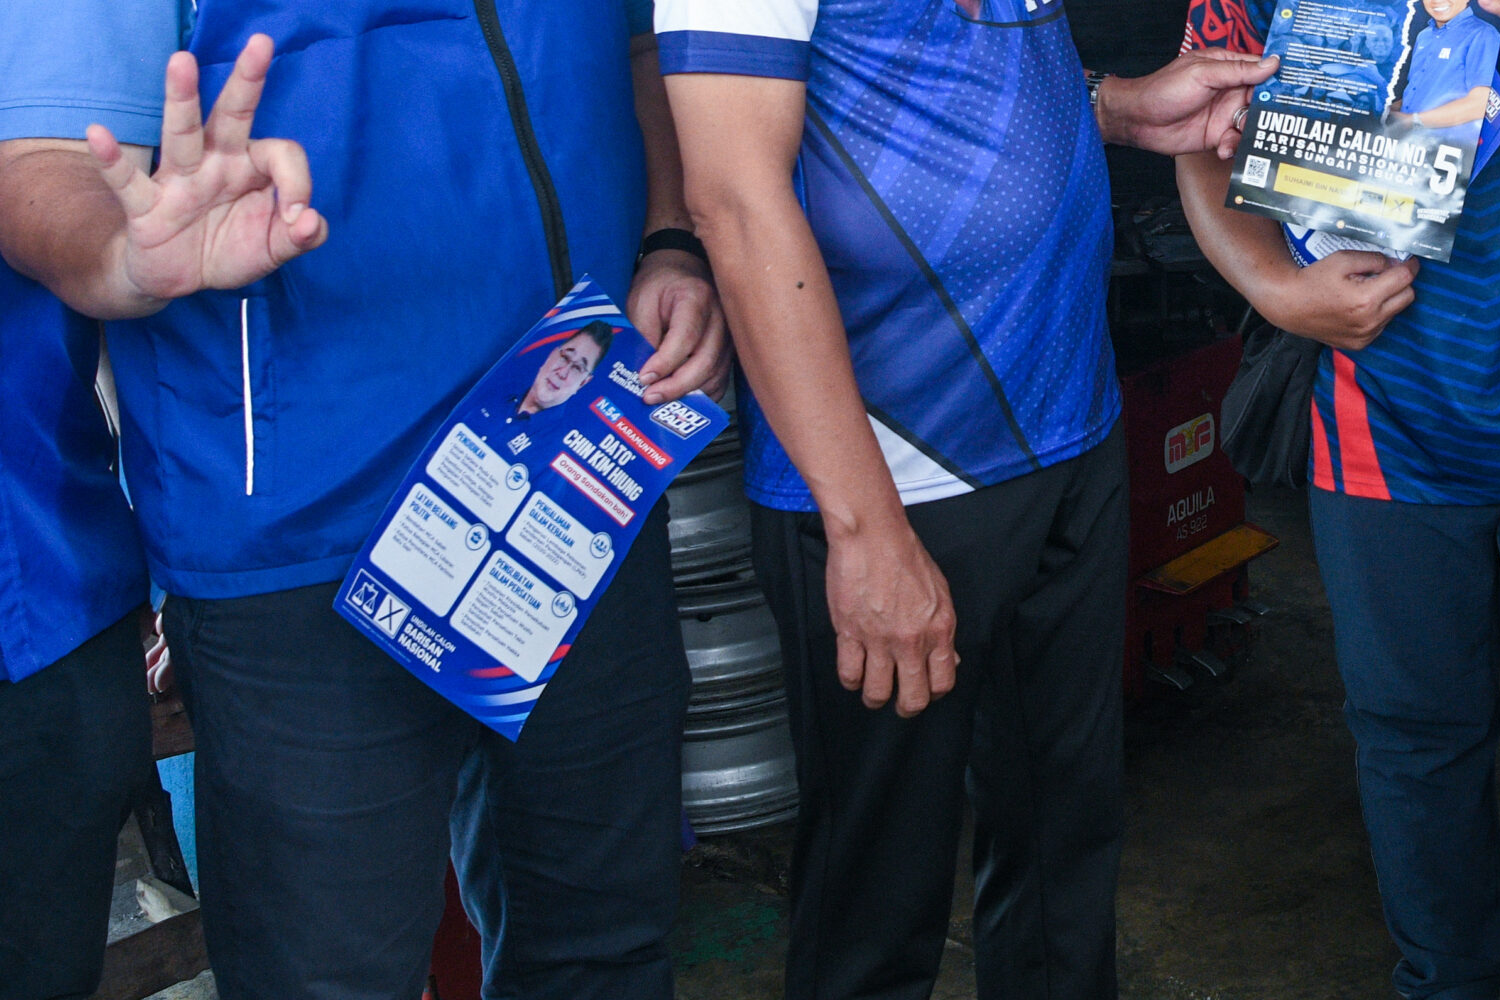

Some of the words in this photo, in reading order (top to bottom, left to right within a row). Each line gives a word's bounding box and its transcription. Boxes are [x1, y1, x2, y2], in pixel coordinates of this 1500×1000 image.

[1252, 138, 1288, 156] N.52
[1292, 148, 1352, 171] SUNGAI
[1254, 129, 1330, 156] BARISAN
[1334, 147, 1417, 176] NASIONAL
[1256, 107, 1337, 146] UNDILAH
[1337, 125, 1399, 161] CALON
[1426, 142, 1464, 197] 5
[607, 369, 647, 398] DemiSaba
[594, 395, 622, 423] N.54
[614, 419, 667, 467] KARAMUNTING
[597, 431, 637, 470] DATO'
[557, 458, 582, 481] Orang
[580, 475, 615, 507] Sandakan
[562, 426, 597, 461] CHIN
[586, 448, 616, 478] KIM
[605, 464, 645, 504] HIUNG
[414, 490, 434, 509] LATAR
[430, 503, 459, 530] BELAKANG
[534, 498, 572, 531] PENGALAMAN
[1166, 486, 1215, 527] AQUILA
[527, 507, 549, 528] DALAM
[545, 521, 575, 548] KERAJAAN
[1176, 523, 1189, 541] AS
[1190, 514, 1208, 535] 922
[488, 566, 510, 586] DALAM
[506, 580, 542, 611] PERSATUAN
[494, 557, 535, 591] PENGLIBATAN
[396, 632, 444, 674] NASIONAL
[402, 621, 445, 658] BARISAN
[408, 613, 437, 639] UNDILAH
[433, 633, 456, 654] CALON
